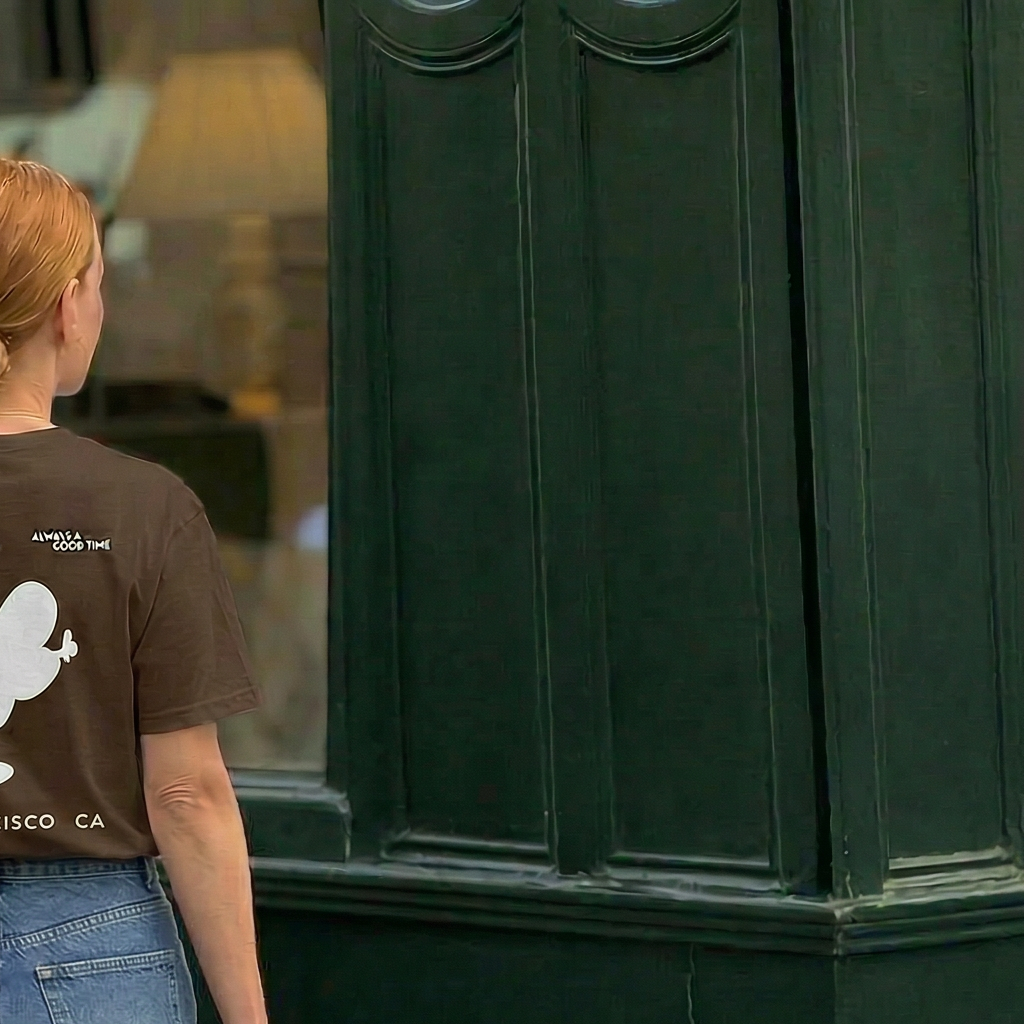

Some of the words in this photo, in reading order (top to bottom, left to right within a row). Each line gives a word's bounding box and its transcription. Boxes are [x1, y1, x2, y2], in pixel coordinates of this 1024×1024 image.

[73, 531, 82, 541] A
[52, 540, 85, 551] GOOD
[85, 539, 111, 551] TIME
[75, 813, 105, 829] CA
